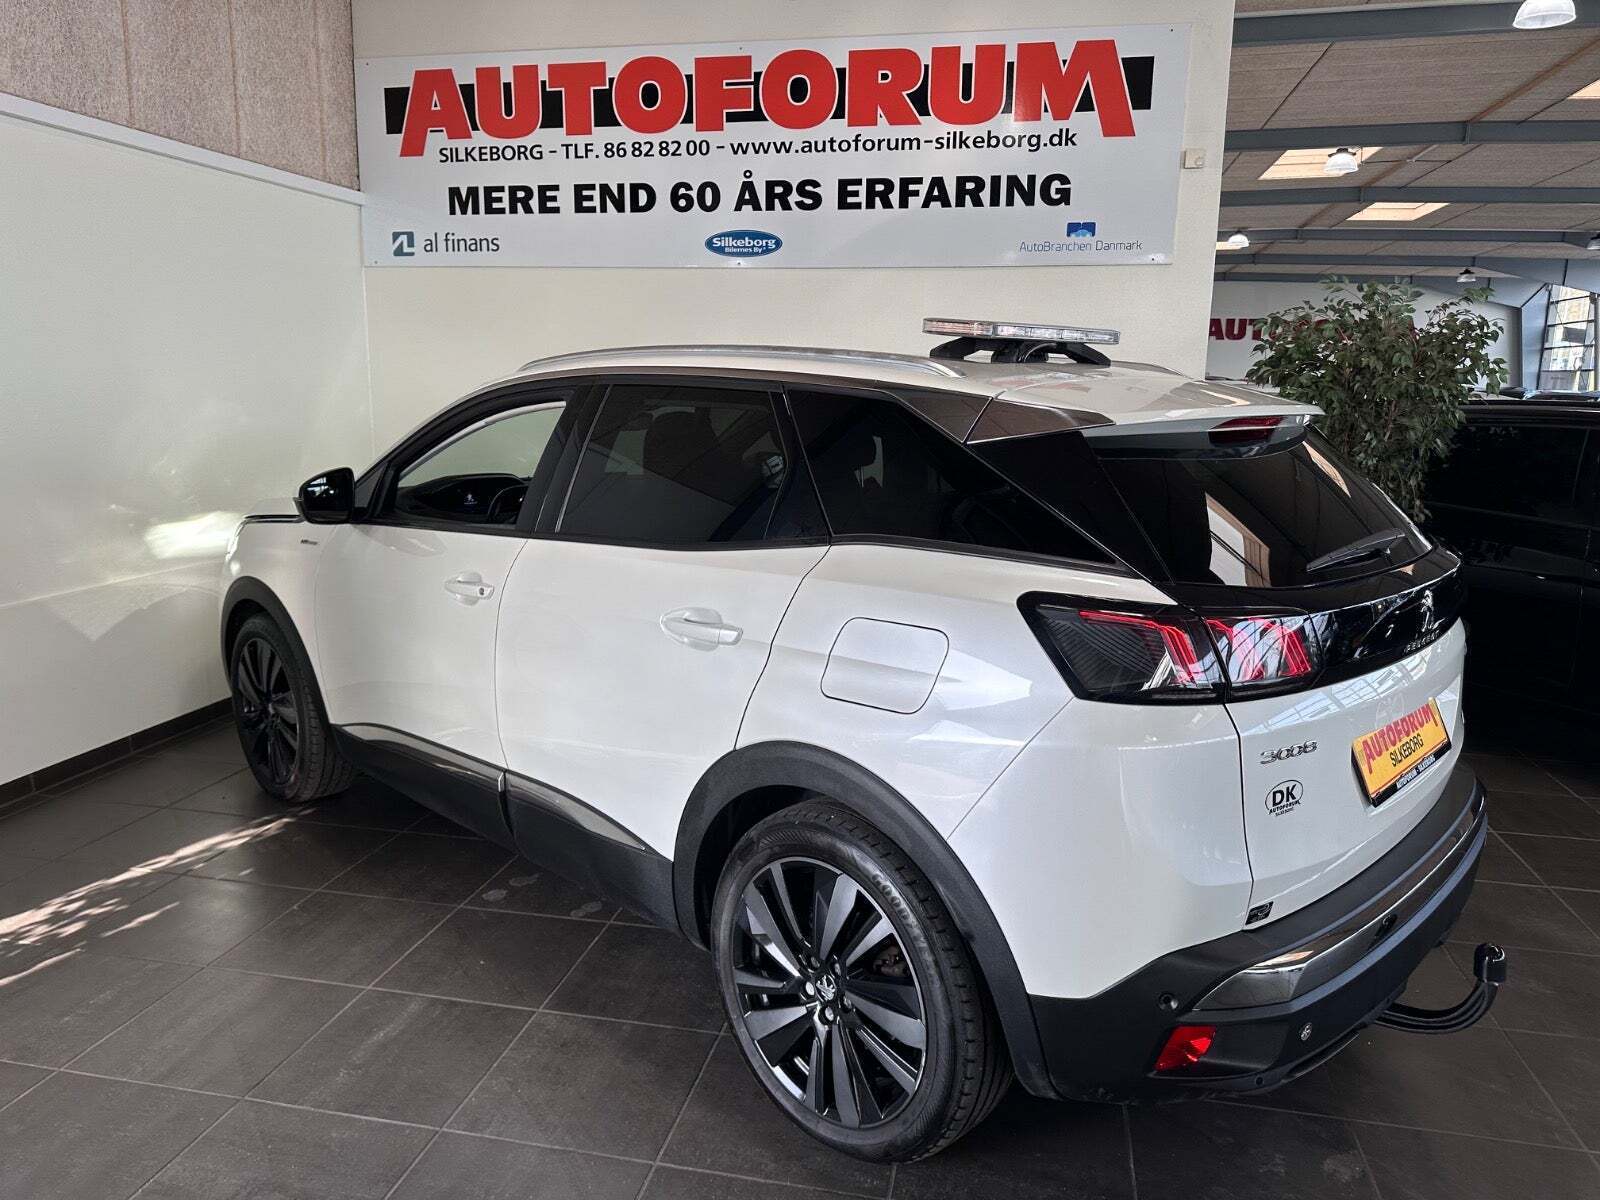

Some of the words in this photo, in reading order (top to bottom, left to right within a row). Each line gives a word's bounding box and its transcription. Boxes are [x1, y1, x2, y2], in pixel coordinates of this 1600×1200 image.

[400, 39, 1136, 157] AUTOFORUM
[438, 144, 545, 164] SILKEBORG
[560, 142, 600, 160] TLF.
[729, 127, 1078, 156] www.autoforum-silkeborg.dk
[447, 184, 560, 216] MERE
[573, 182, 657, 214] END
[669, 180, 721, 212] 60
[733, 169, 823, 212] ÅRS
[836, 172, 1072, 211] ERFARING
[423, 233, 439, 252] al
[442, 232, 500, 252] finans
[712, 236, 777, 249] Silkeborg
[1019, 240, 1092, 253] AutoBranchen
[1095, 239, 1143, 251] Danmark
[1260, 740, 1318, 765] 3008
[1362, 703, 1438, 775] AUTOFORUM
[1389, 733, 1424, 767] SILKEBORG
[1272, 783, 1297, 807] DK
